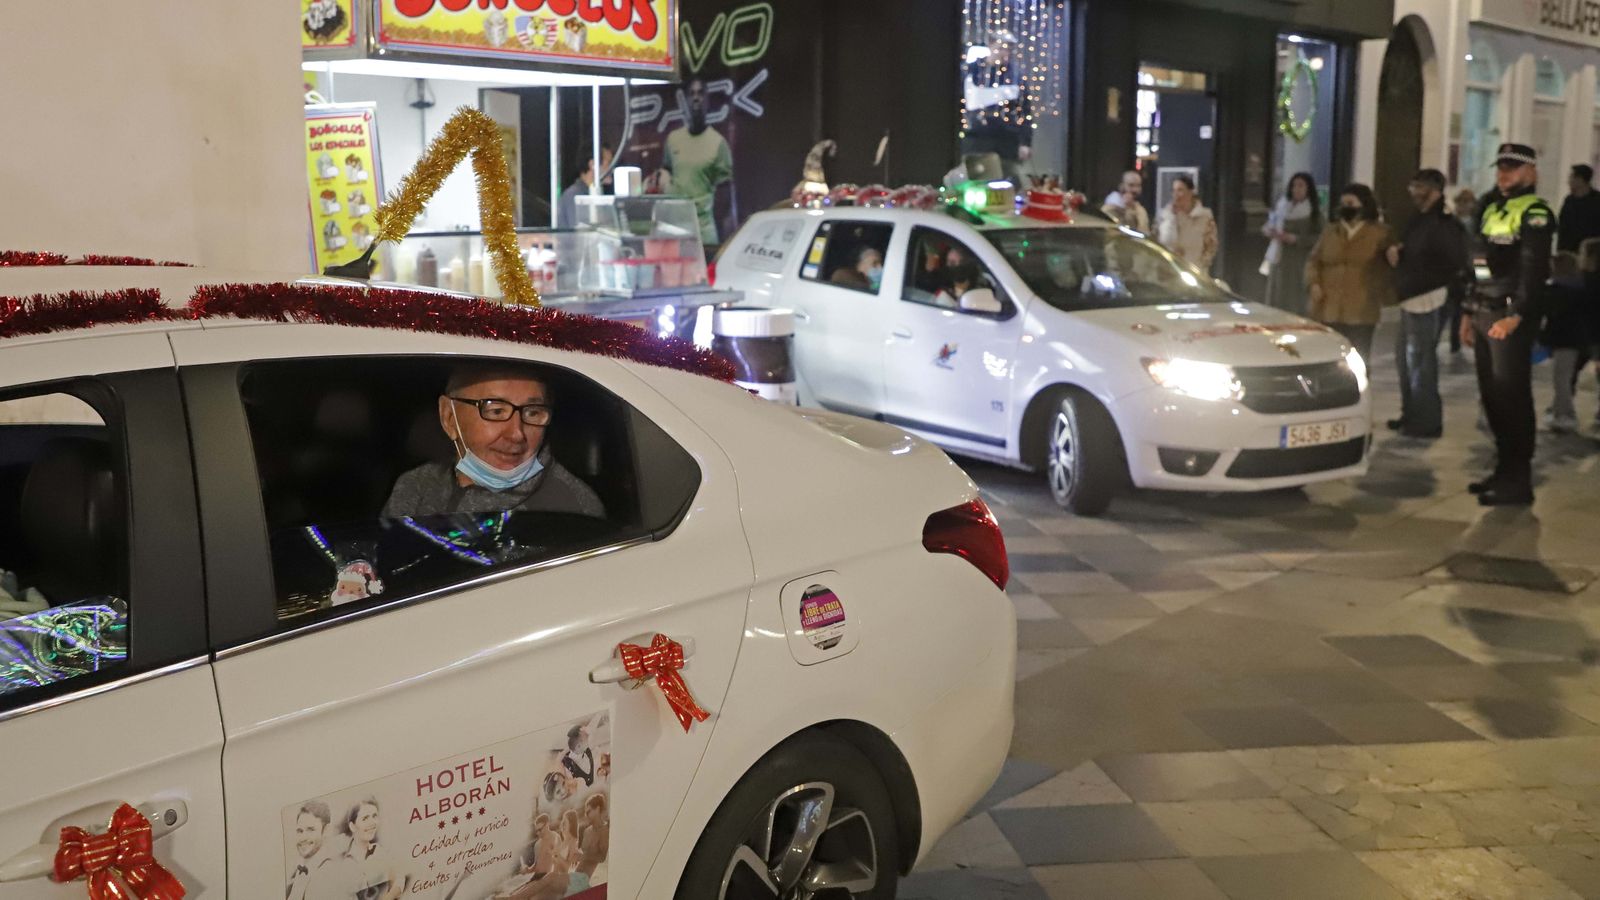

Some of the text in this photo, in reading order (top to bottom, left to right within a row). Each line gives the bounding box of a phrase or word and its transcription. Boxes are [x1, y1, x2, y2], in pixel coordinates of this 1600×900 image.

[1290, 425, 1320, 445] 5436
[416, 756, 504, 796] HOTEL
[409, 777, 511, 824] ALBORÁN
[411, 814, 509, 858] Calidad y servicio
[428, 841, 494, 870] 4 estrellas
[411, 851, 512, 894] Eventos y Reuniones
